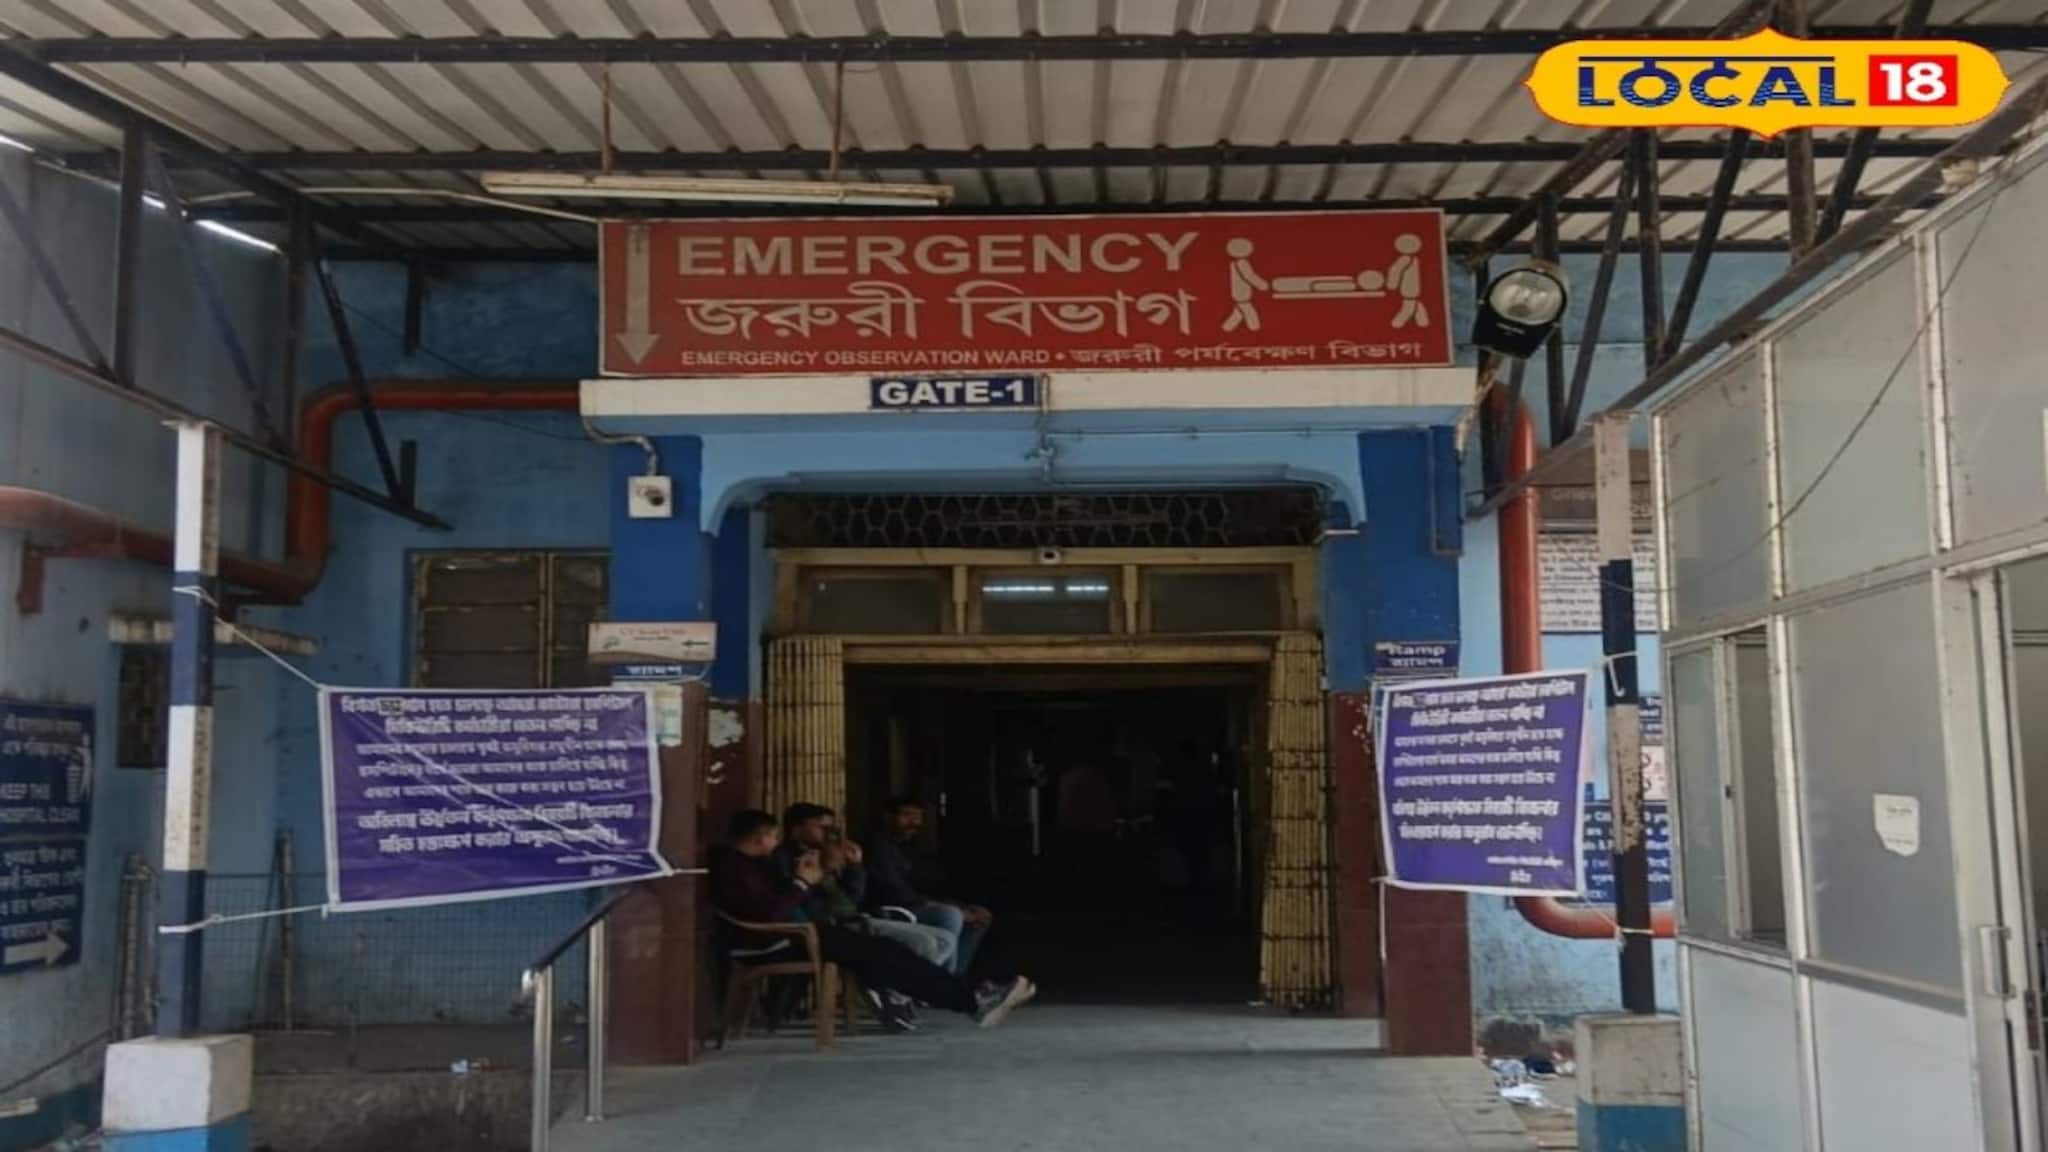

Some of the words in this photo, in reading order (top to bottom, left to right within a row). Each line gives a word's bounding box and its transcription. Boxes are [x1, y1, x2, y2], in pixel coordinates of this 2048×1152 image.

[678, 232, 1199, 276] EMERGENCY
[674, 280, 925, 340] জরুরী
[945, 280, 1198, 339] বিভাগ
[681, 350, 818, 366] EMERGENCY
[824, 349, 979, 365] OBSERVATION
[984, 348, 1050, 364] WARD
[1327, 340, 1423, 359] বিভাগ
[877, 380, 1025, 406] GATE-1
[1388, 645, 1446, 656] Ramp
